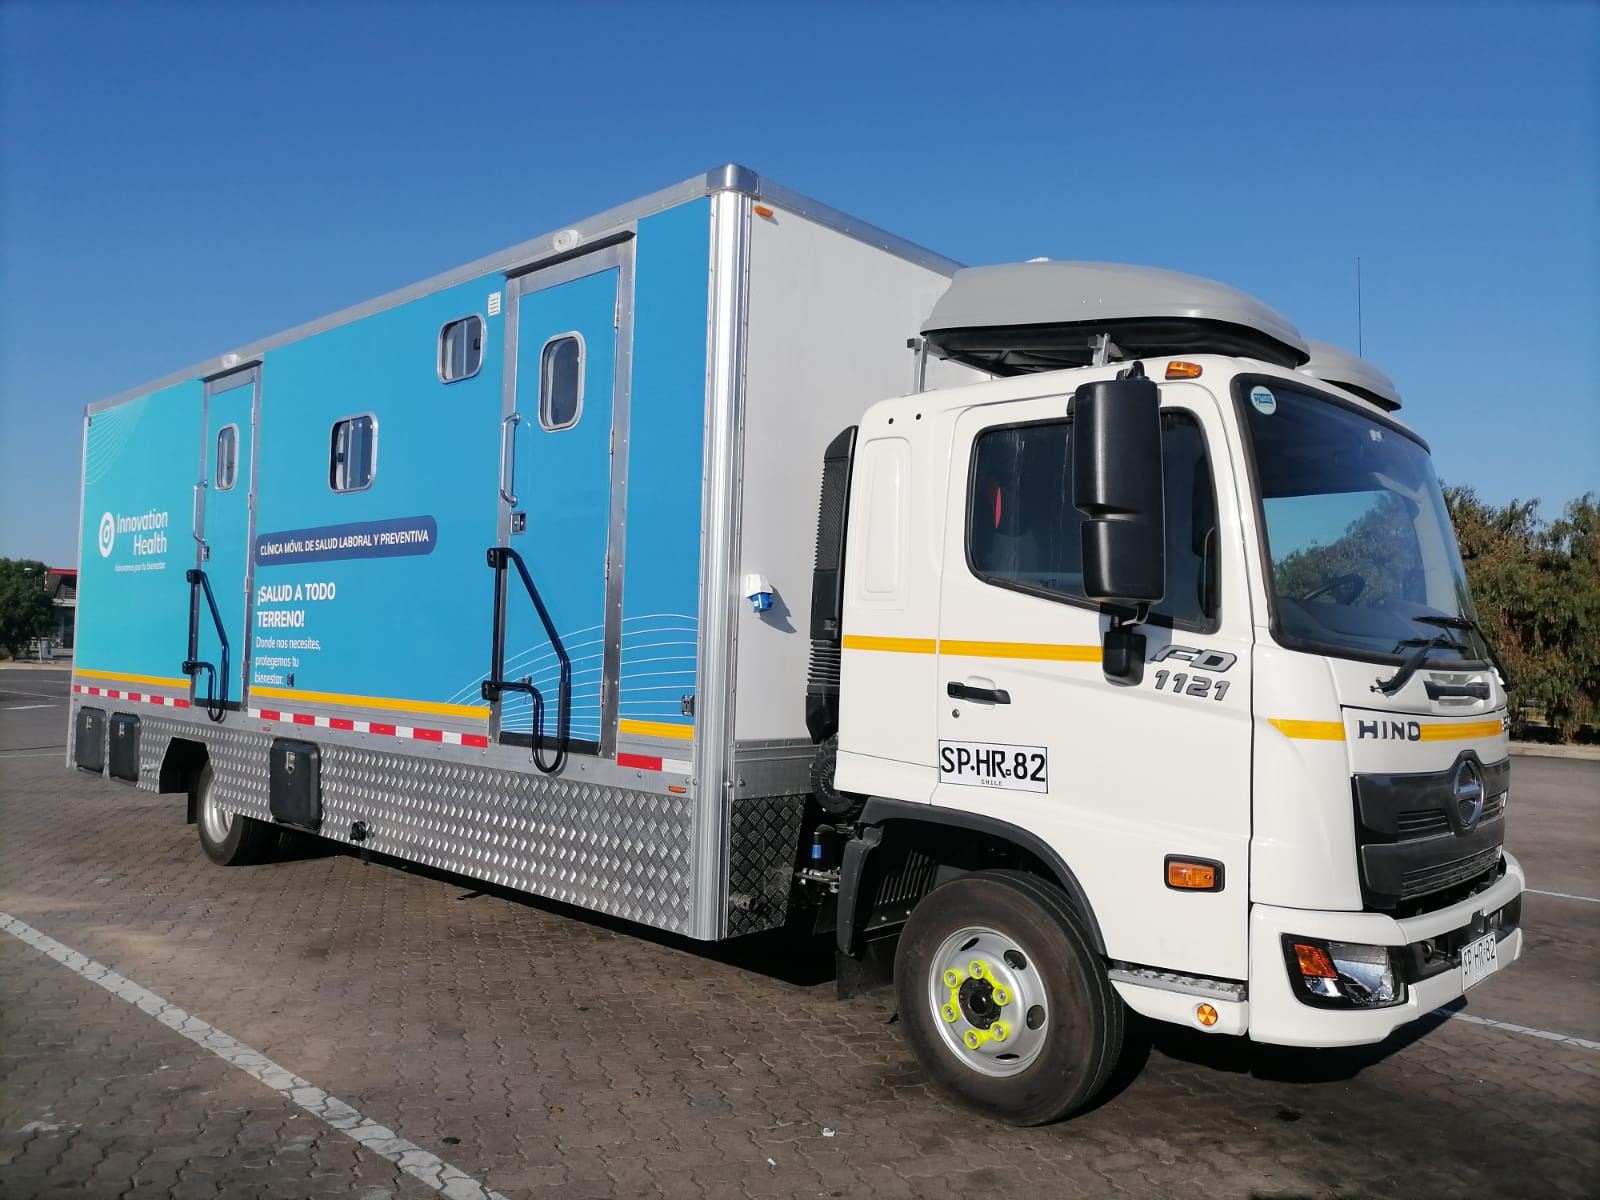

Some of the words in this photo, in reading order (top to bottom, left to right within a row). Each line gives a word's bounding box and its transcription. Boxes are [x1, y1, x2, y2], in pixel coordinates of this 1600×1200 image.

[117, 508, 168, 534] Innovation
[133, 530, 167, 556] Health
[260, 541, 283, 556] CLÍNICA
[284, 539, 304, 554] MÓVIL
[305, 540, 314, 551] DE
[315, 537, 338, 550] SALUD
[339, 534, 372, 548] LABORAL
[373, 533, 379, 546] Y
[380, 529, 429, 545] PREVENTIVA
[257, 584, 293, 606] ¡SALUD
[294, 584, 302, 601] A
[305, 582, 336, 601] TODO
[257, 610, 305, 628] TERRENO!
[255, 636, 276, 649] Donde
[276, 640, 288, 649] nos
[289, 636, 321, 652] necesites,
[255, 656, 291, 669] protegemos
[292, 656, 300, 668] tu
[1150, 644, 1237, 673] FD
[1154, 669, 1231, 702] 1121
[1358, 719, 1421, 742] HINO
[981, 779, 1003, 787] CHILE
